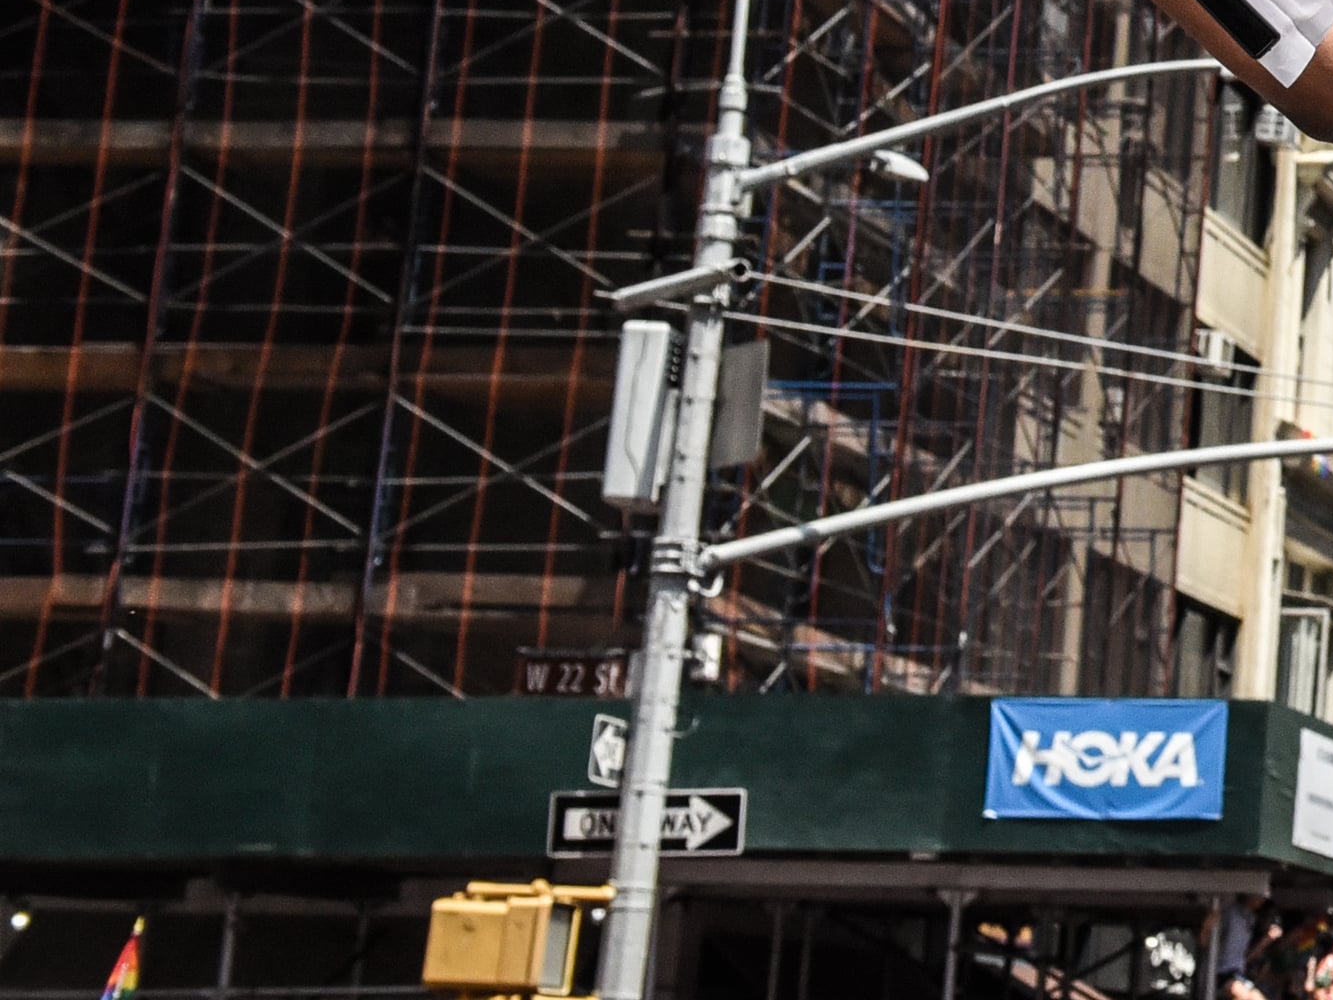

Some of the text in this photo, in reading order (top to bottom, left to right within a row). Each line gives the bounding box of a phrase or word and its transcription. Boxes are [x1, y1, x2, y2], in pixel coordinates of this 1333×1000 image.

[526, 662, 620, 694] W 22 St
[1012, 730, 1199, 787] HOKA
[579, 811, 616, 838] ON
